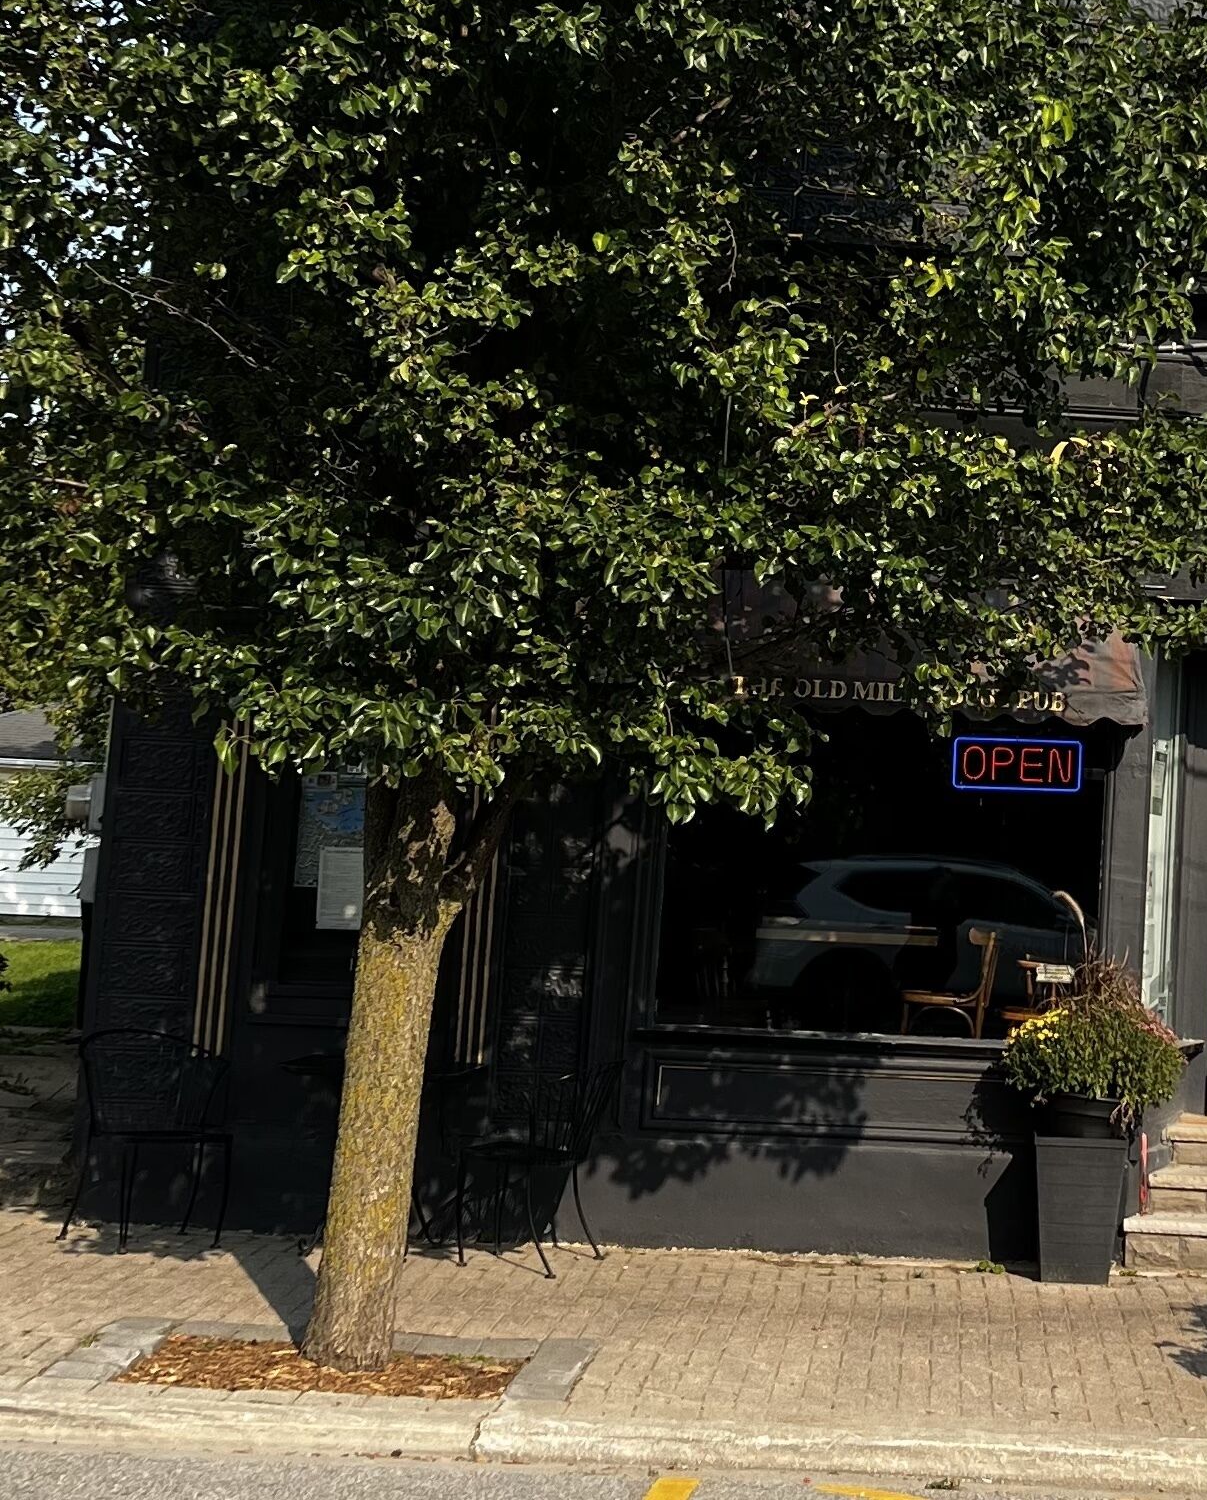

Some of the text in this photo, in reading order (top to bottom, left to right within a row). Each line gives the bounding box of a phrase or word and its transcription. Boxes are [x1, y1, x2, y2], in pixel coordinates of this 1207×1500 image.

[793, 677, 848, 699] OLD
[852, 681, 906, 702] MIL
[1016, 690, 1066, 713] PUB
[963, 745, 1072, 783] OPEN
